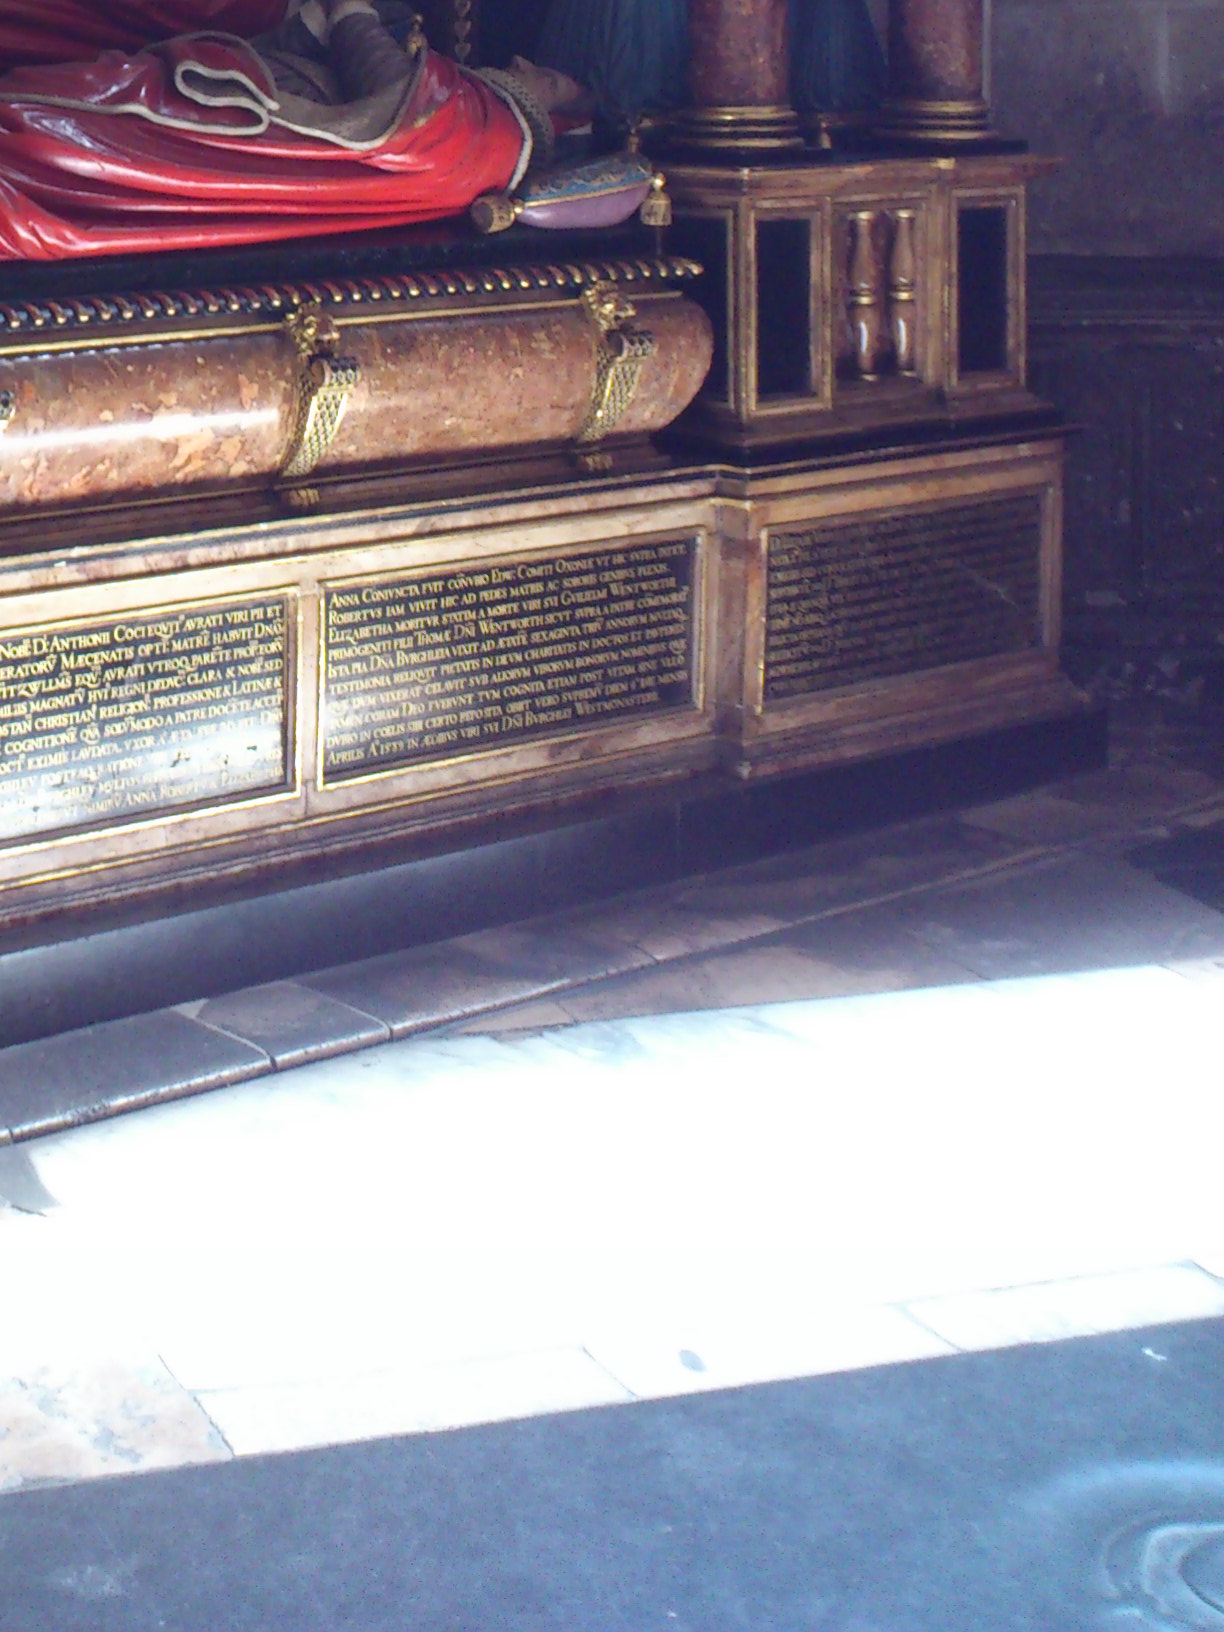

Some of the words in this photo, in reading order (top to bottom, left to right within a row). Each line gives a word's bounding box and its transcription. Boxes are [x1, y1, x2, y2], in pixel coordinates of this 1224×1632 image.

[329, 593, 359, 608] ANNA
[422, 580, 444, 594] FVIT
[328, 607, 381, 625] ROBERTVS
[386, 604, 404, 616] IAM
[408, 598, 437, 612] VIVIT
[440, 595, 458, 608] HIC
[460, 592, 476, 604] AD
[49, 631, 109, 652] ANTHONII
[113, 625, 144, 641] COCI
[183, 613, 222, 631] AVRATI
[225, 610, 248, 623] VIRI
[250, 607, 263, 620] PII
[266, 605, 281, 617] ET
[212, 627, 252, 644] HABVIT
[103, 663, 144, 681] AVRATI
[111, 681, 145, 698] REGNI
[186, 669, 221, 684] CLARA
[225, 666, 234, 678] &
[263, 658, 282, 671] SED
[477, 689, 500, 702] TVM
[407, 737, 418, 749] IN
